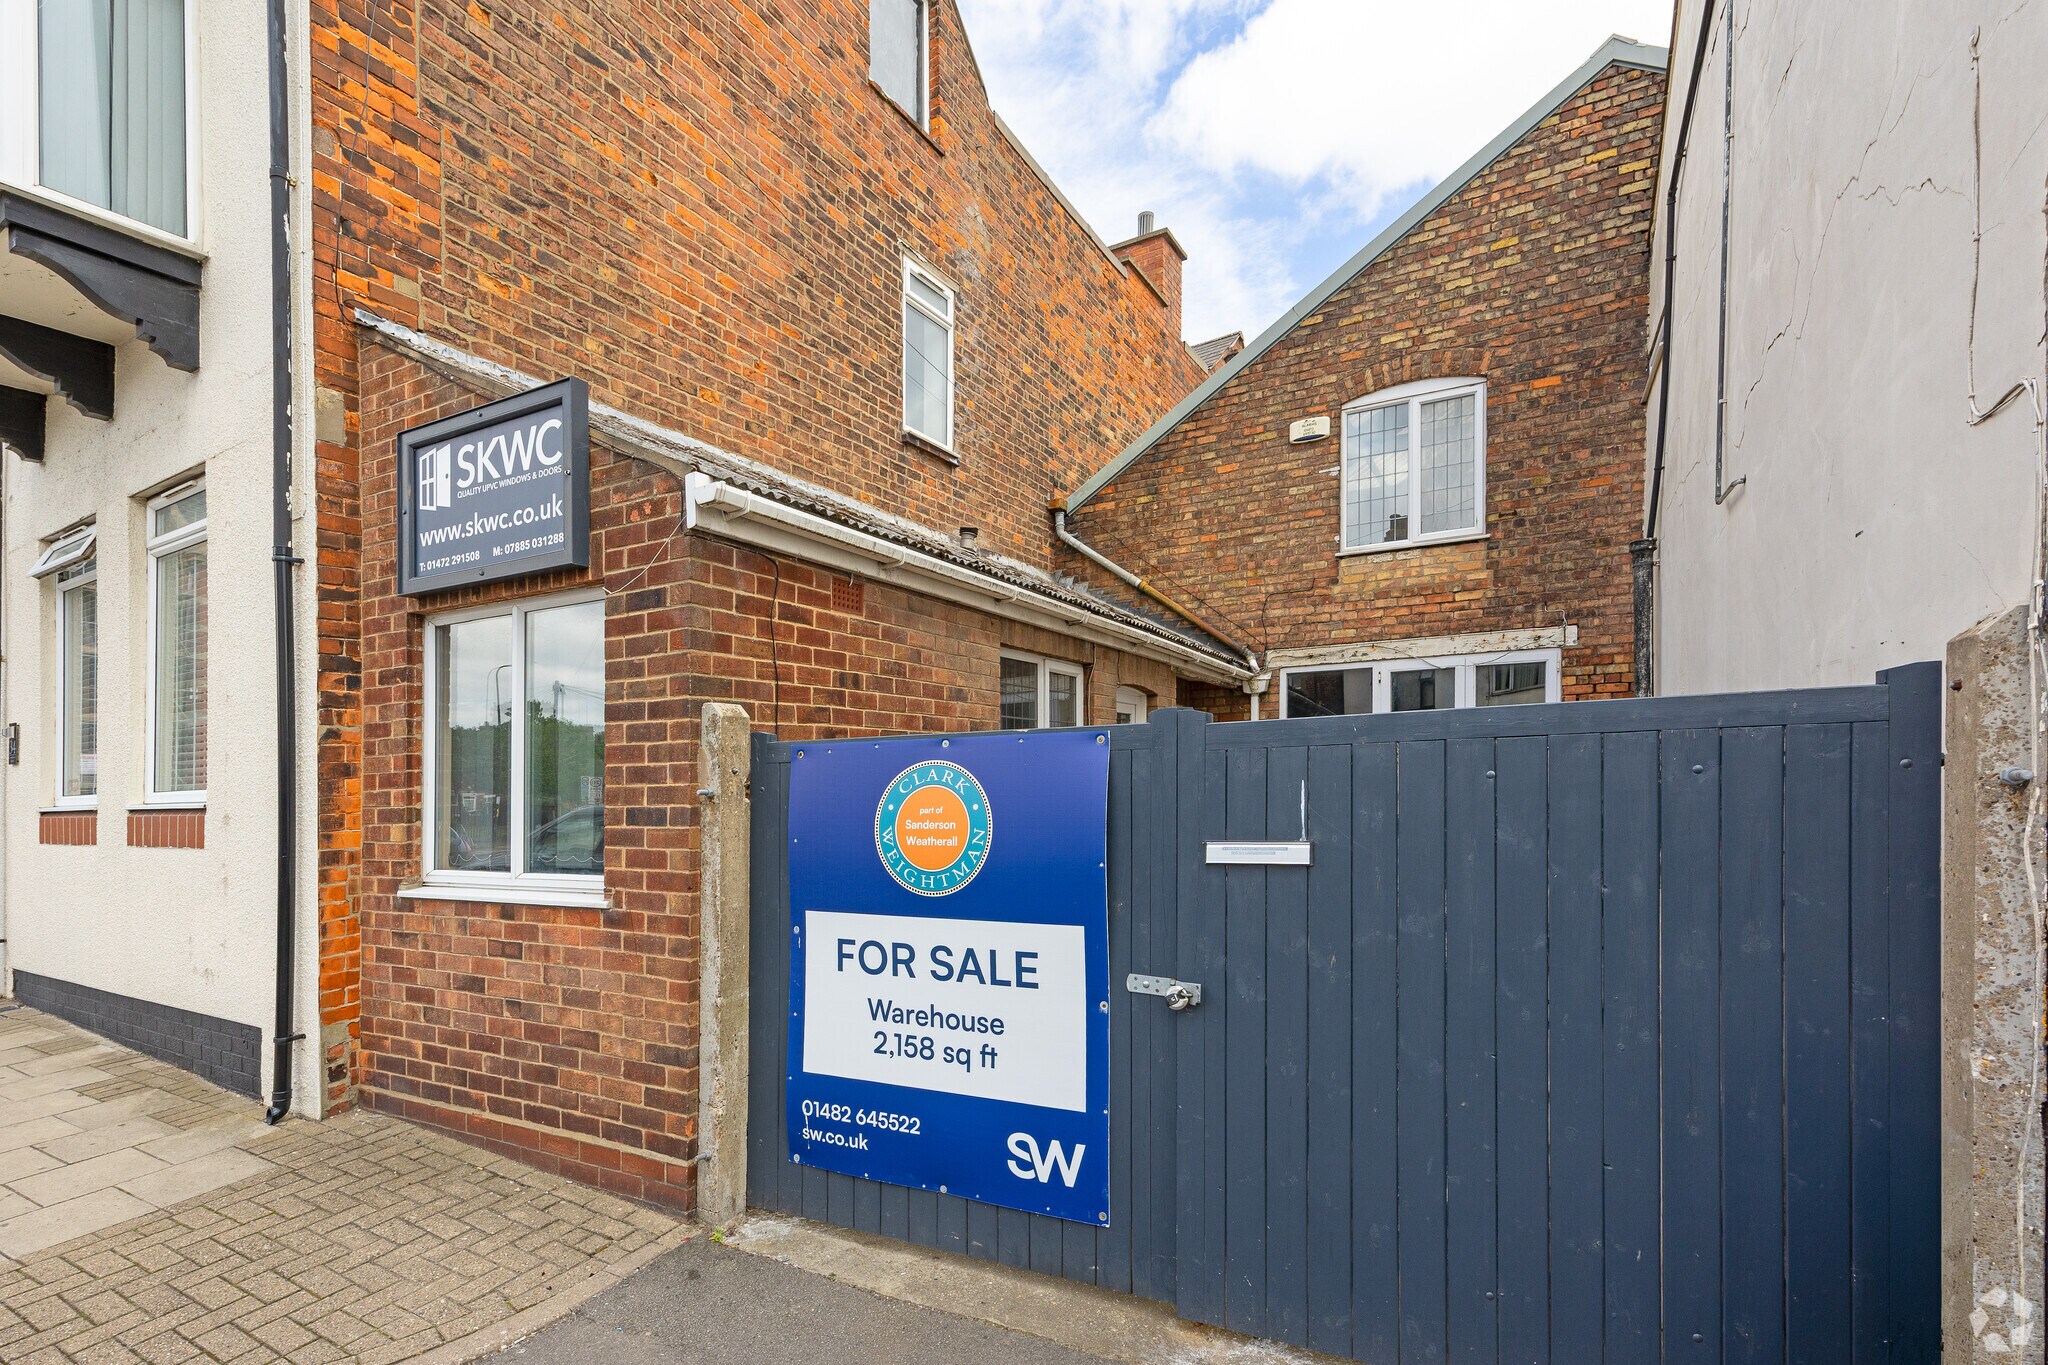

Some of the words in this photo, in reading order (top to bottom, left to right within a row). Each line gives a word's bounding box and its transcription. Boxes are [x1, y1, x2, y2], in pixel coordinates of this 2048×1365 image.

[456, 419, 563, 487] SKWC
[457, 486, 482, 499] QUALITY
[482, 483, 499, 494] UPVC
[499, 473, 531, 489] WINDOWS
[532, 472, 538, 480] &
[538, 465, 562, 477] DOORS
[419, 493, 563, 547] www.skwc.co.uk
[419, 562, 426, 572] T:
[426, 558, 450, 571] 01472
[451, 550, 480, 565] 291508
[492, 546, 503, 557] M:
[504, 541, 530, 555] 07885
[532, 532, 564, 549] 031288
[899, 768, 970, 795] CLARK
[905, 819, 956, 830] Sanderson
[936, 806, 943, 814] of
[882, 825, 985, 888] WEIGHTMAN
[906, 836, 958, 847] Weatherall
[837, 938, 916, 978] FOR
[930, 945, 1039, 989] SALE
[867, 998, 1005, 1035] Warehouse
[873, 1031, 935, 1060] 2,158
[943, 1046, 971, 1072] sq
[979, 1044, 998, 1069] ft
[802, 1100, 851, 1123] 01482
[856, 1109, 921, 1135] 645522
[802, 1128, 868, 1151] sw.co.uk
[1007, 1132, 1086, 1188] SW
